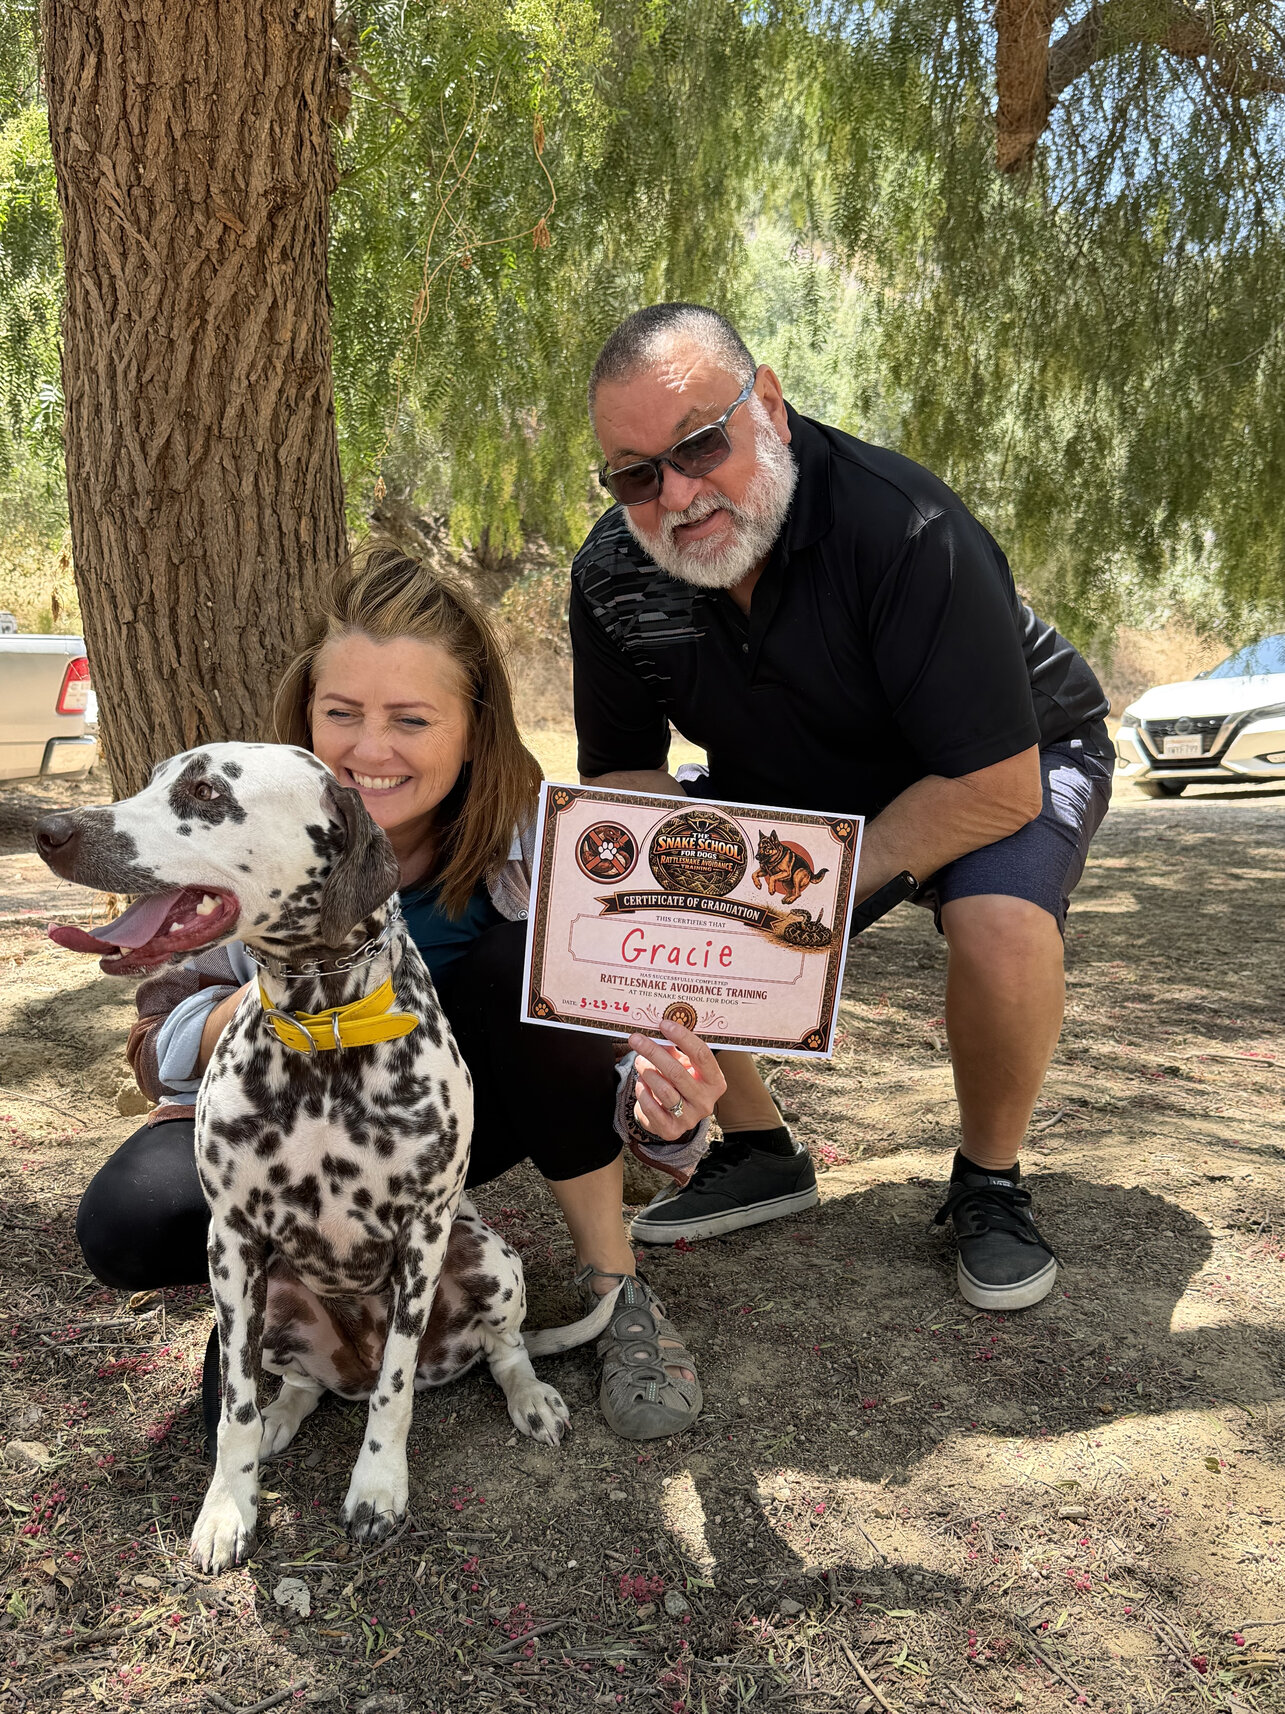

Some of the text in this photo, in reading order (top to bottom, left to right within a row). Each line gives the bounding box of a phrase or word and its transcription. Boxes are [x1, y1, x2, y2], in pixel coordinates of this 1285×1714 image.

[692, 832, 710, 840] THE
[658, 836, 740, 859] SNAKE SCHOOL
[696, 850, 717, 859] DOGS
[660, 855, 733, 871] RATTLESNAKE AVOIDANCE
[681, 864, 712, 872] TRAINING
[623, 895, 760, 920] CERTIFICATE OF GRADUATION
[673, 917, 707, 926] CERTIFIES
[621, 928, 733, 968] Gracie
[652, 975, 694, 983] SUCCESSFULLY
[695, 978, 728, 986] COMPLETED
[600, 974, 768, 1000] RATTLESNAKE AVOIDANCE TRAINING
[677, 994, 705, 1002] SCHOOL
